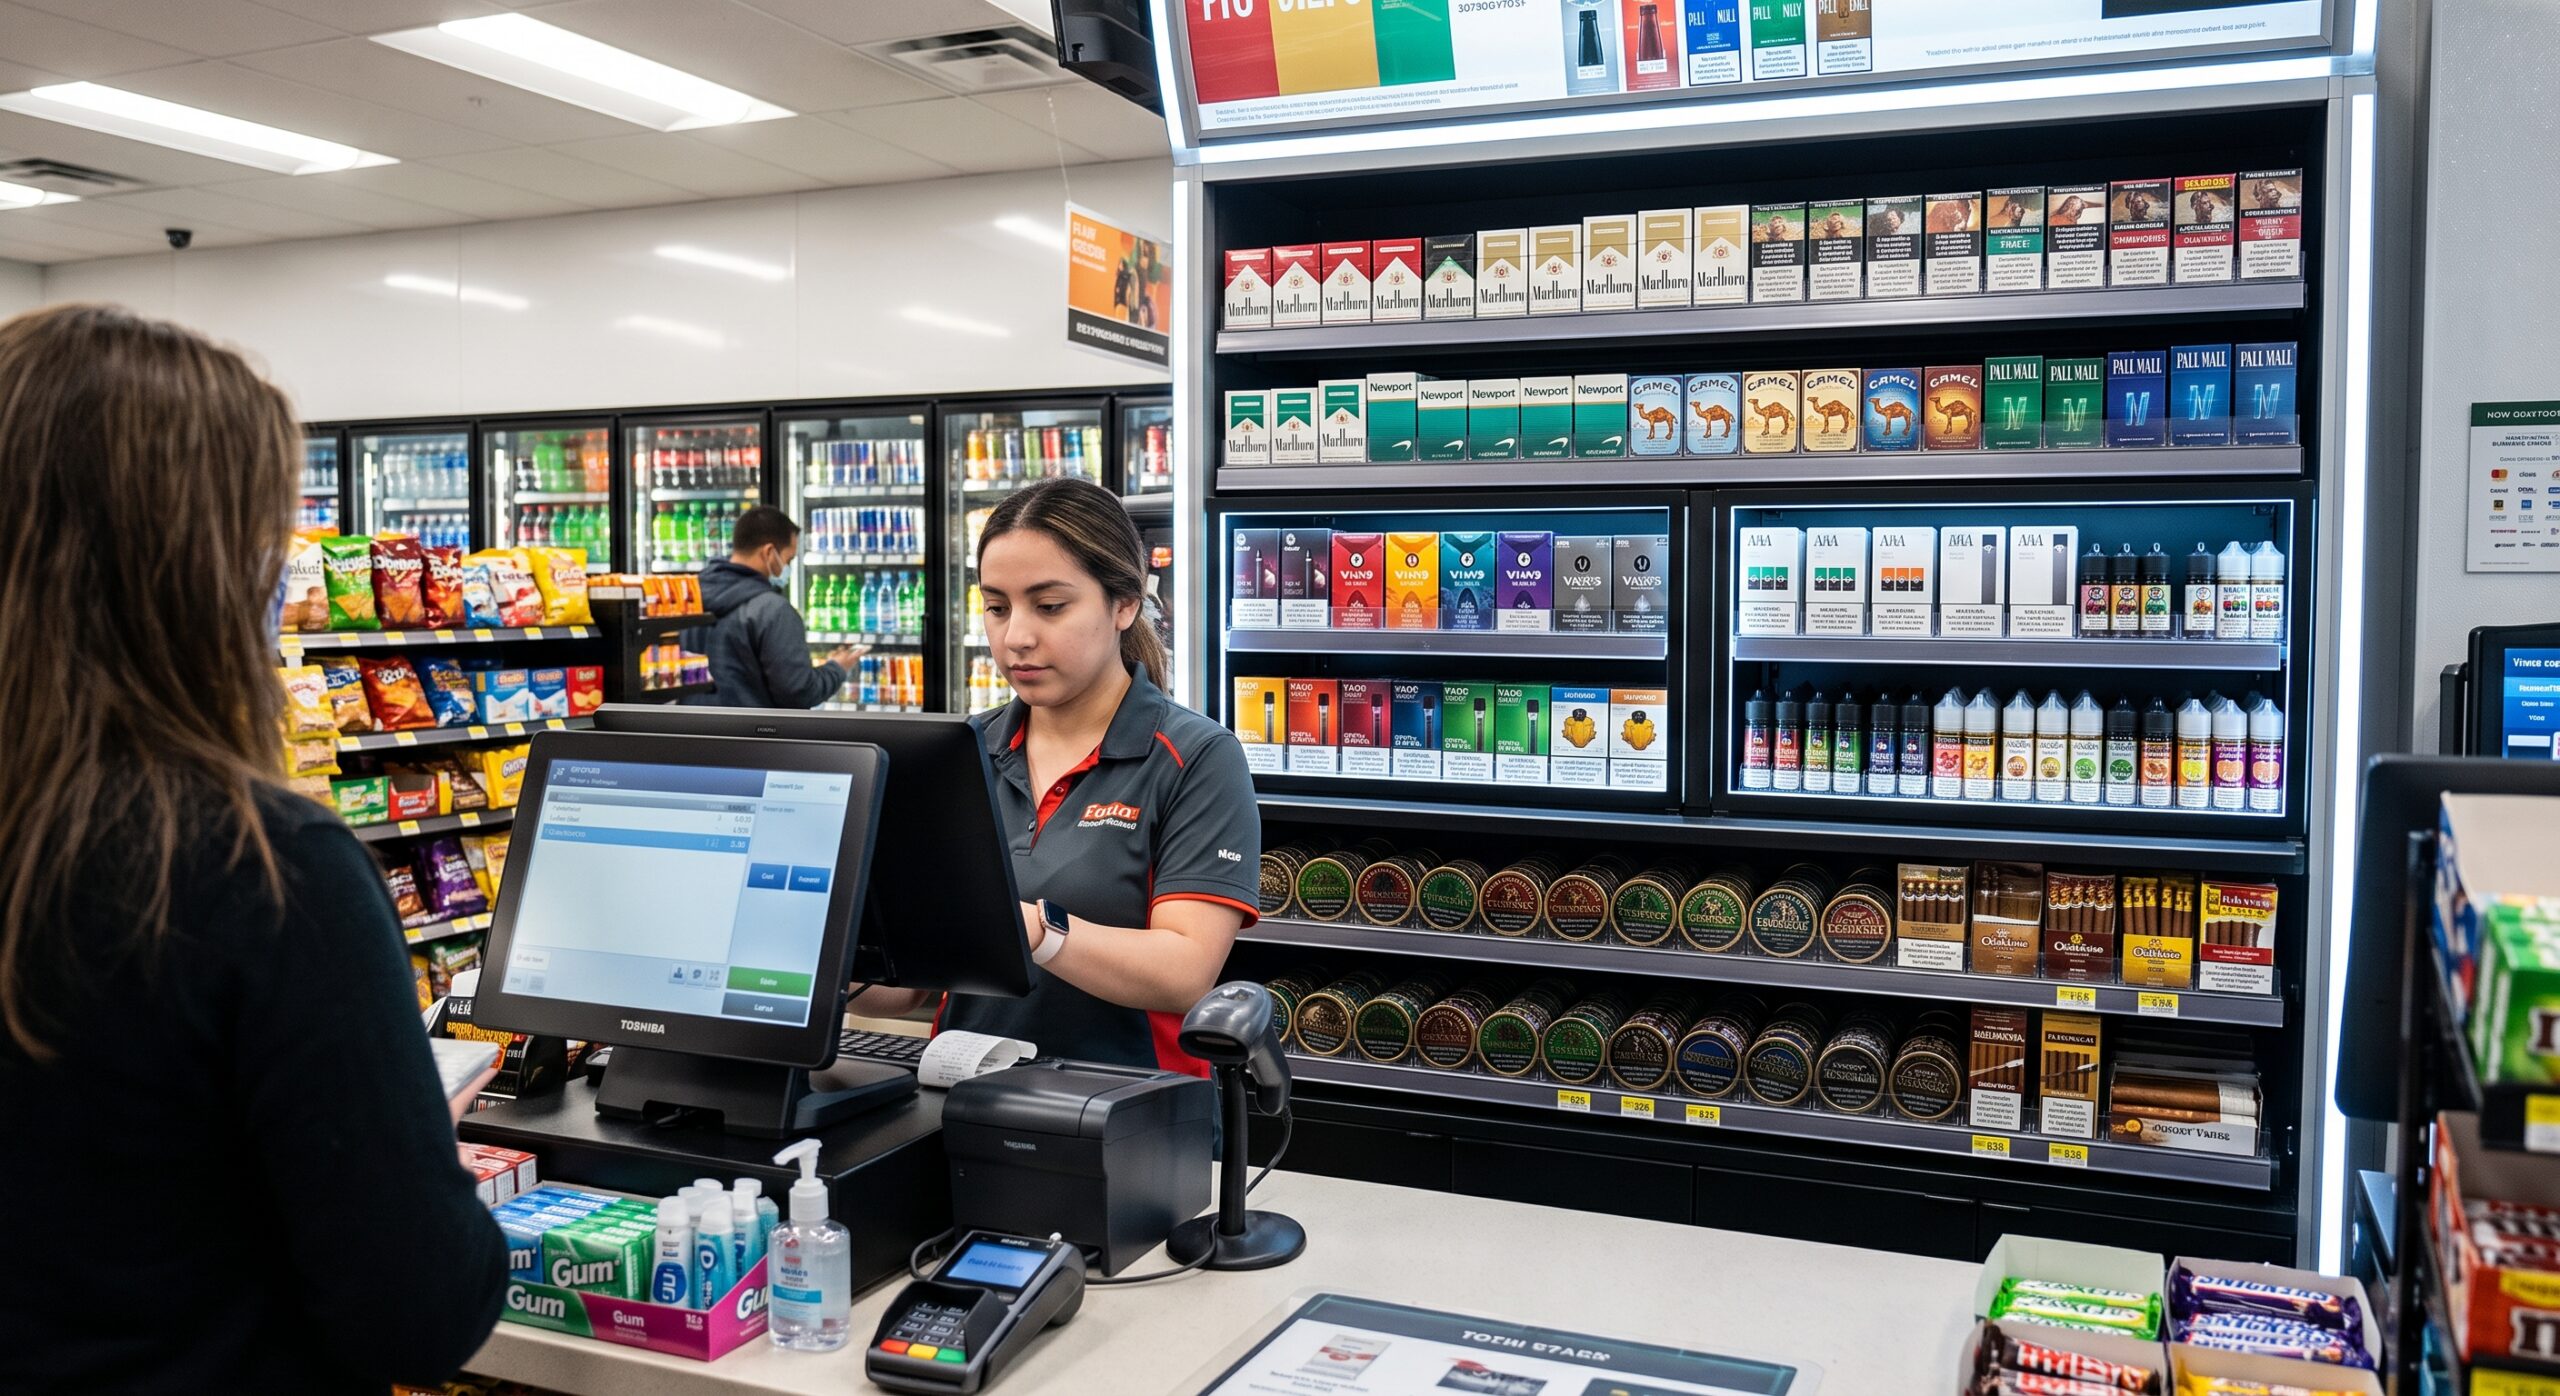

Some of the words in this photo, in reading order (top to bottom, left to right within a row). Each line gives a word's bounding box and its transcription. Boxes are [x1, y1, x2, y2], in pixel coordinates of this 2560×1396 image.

[2113, 358, 2135, 375] PALL
[2136, 357, 2162, 374] MALL
[2176, 351, 2199, 368] PALL
[2201, 350, 2227, 368] MALL
[2240, 350, 2264, 367] PALL
[2266, 349, 2293, 366] MALL
[1990, 363, 2013, 381] PALL
[2050, 366, 2073, 381] PALL
[2074, 364, 2099, 381] MALL
[1370, 382, 1412, 395] Newport
[1633, 380, 1680, 396] CAMEL
[1689, 379, 1736, 395] CAMEL
[1747, 376, 1795, 392] CAMEL
[1806, 374, 1856, 390] CAMEL
[1868, 374, 1918, 390] CAMEL
[1929, 372, 1979, 389] CAMEL
[1421, 389, 1463, 402] Newport
[1472, 389, 1516, 400] Newport
[1524, 386, 1569, 398] Newport
[1578, 384, 1624, 397] Newport
[2487, 411, 2511, 419] NOW
[620, 1019, 666, 1034] TOSHIBA
[551, 1258, 615, 1287] Gum
[506, 1284, 565, 1318] Gum
[612, 1309, 645, 1327] Gum
